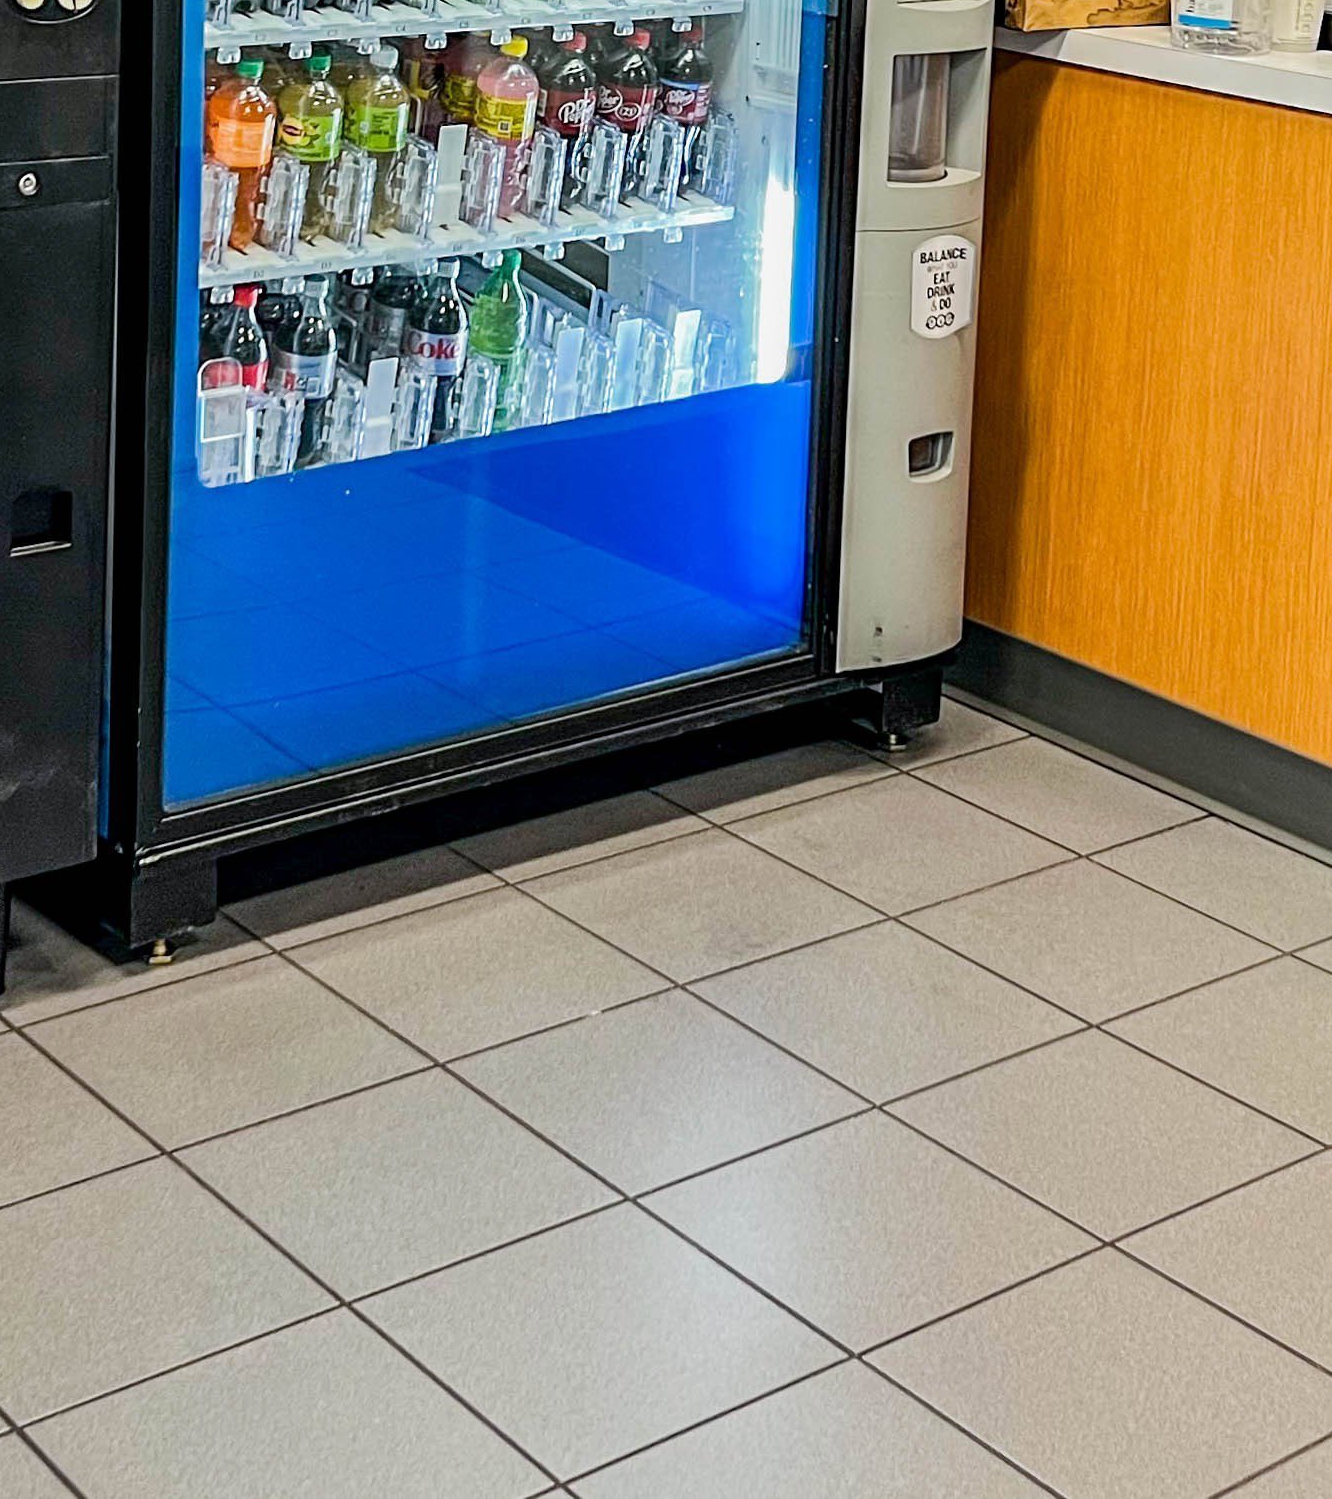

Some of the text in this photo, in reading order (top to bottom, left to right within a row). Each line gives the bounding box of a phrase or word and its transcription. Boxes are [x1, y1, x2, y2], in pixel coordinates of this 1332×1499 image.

[920, 248, 967, 264] BALANCE
[933, 271, 950, 285] EAT
[927, 283, 955, 299] DRINK
[939, 298, 951, 310] DO
